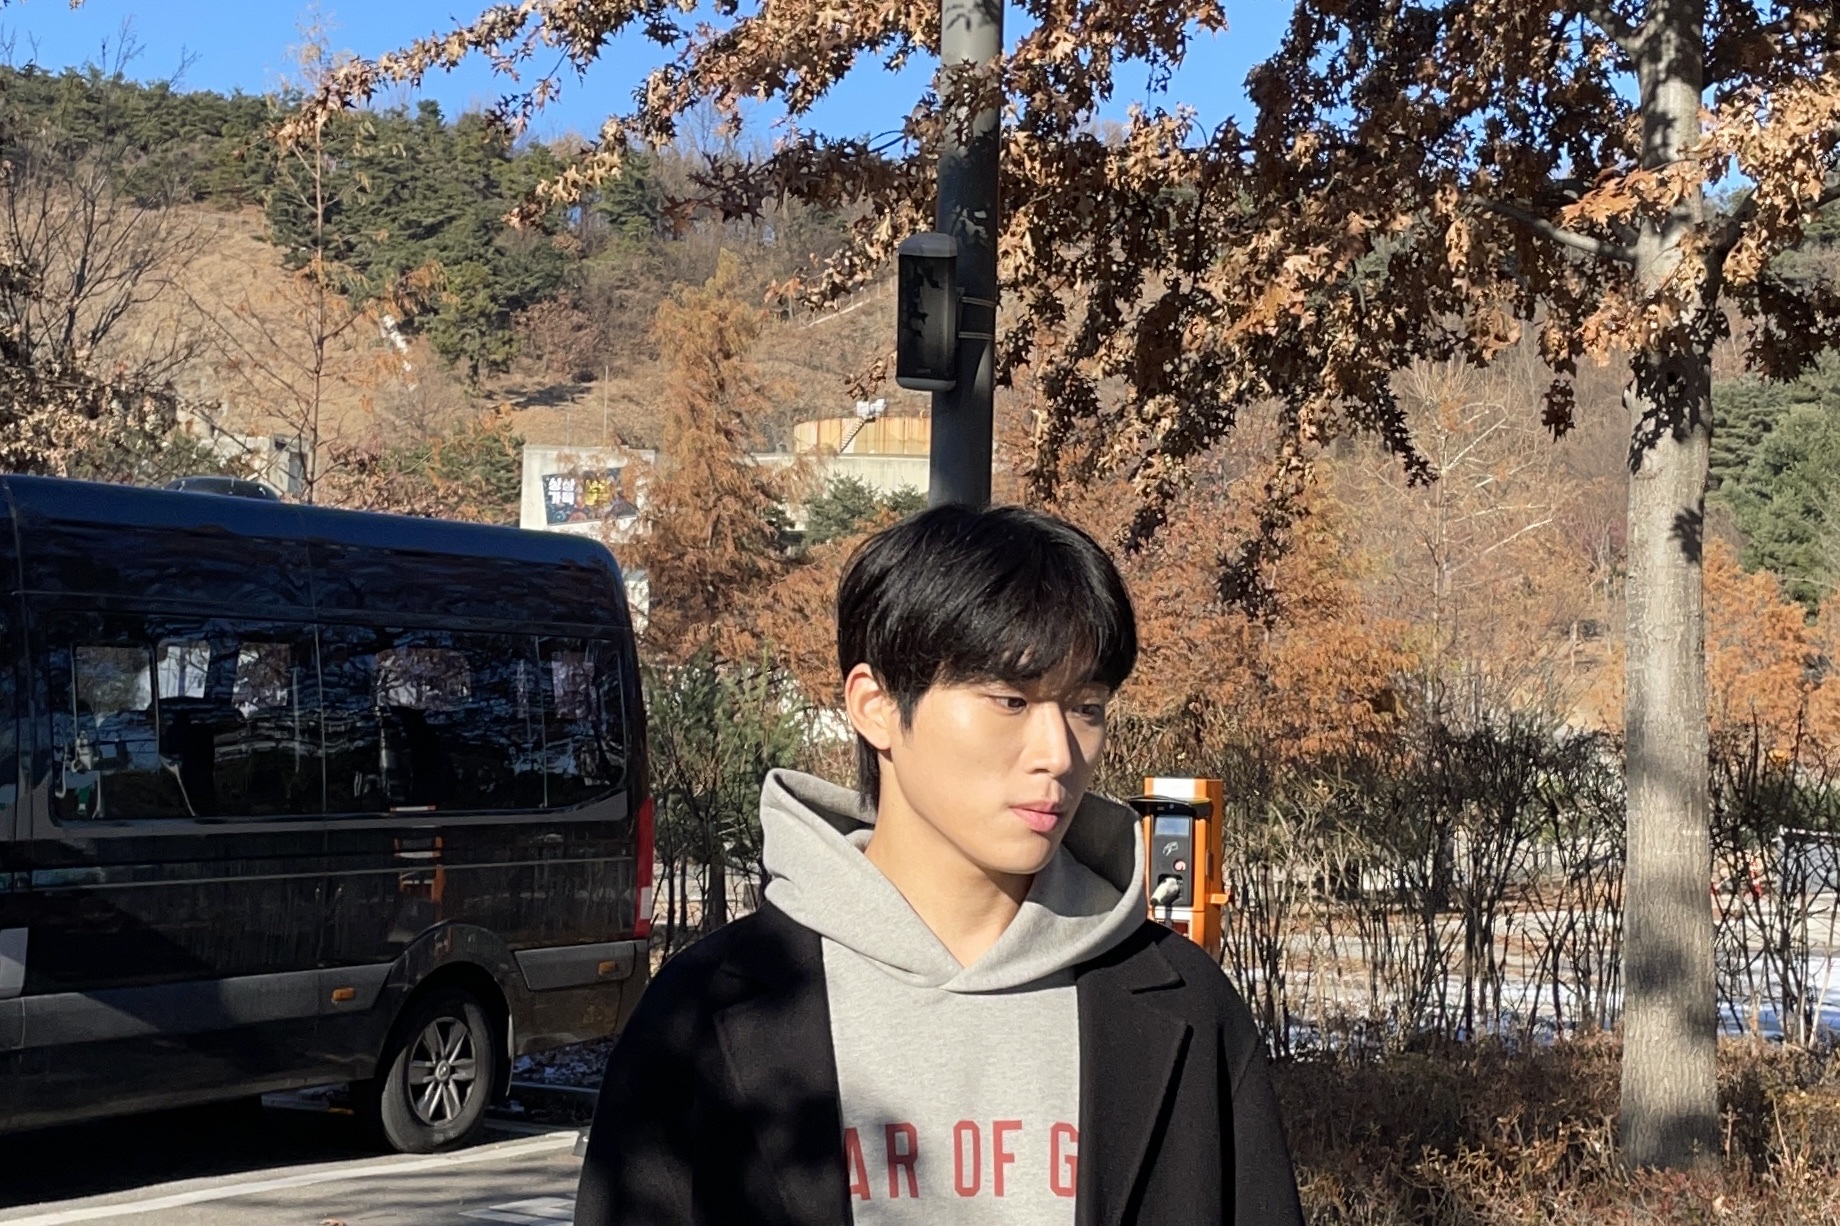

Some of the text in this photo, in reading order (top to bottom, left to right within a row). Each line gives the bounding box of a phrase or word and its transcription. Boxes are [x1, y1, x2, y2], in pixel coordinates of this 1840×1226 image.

[844, 1120, 1078, 1200] AR OF G
